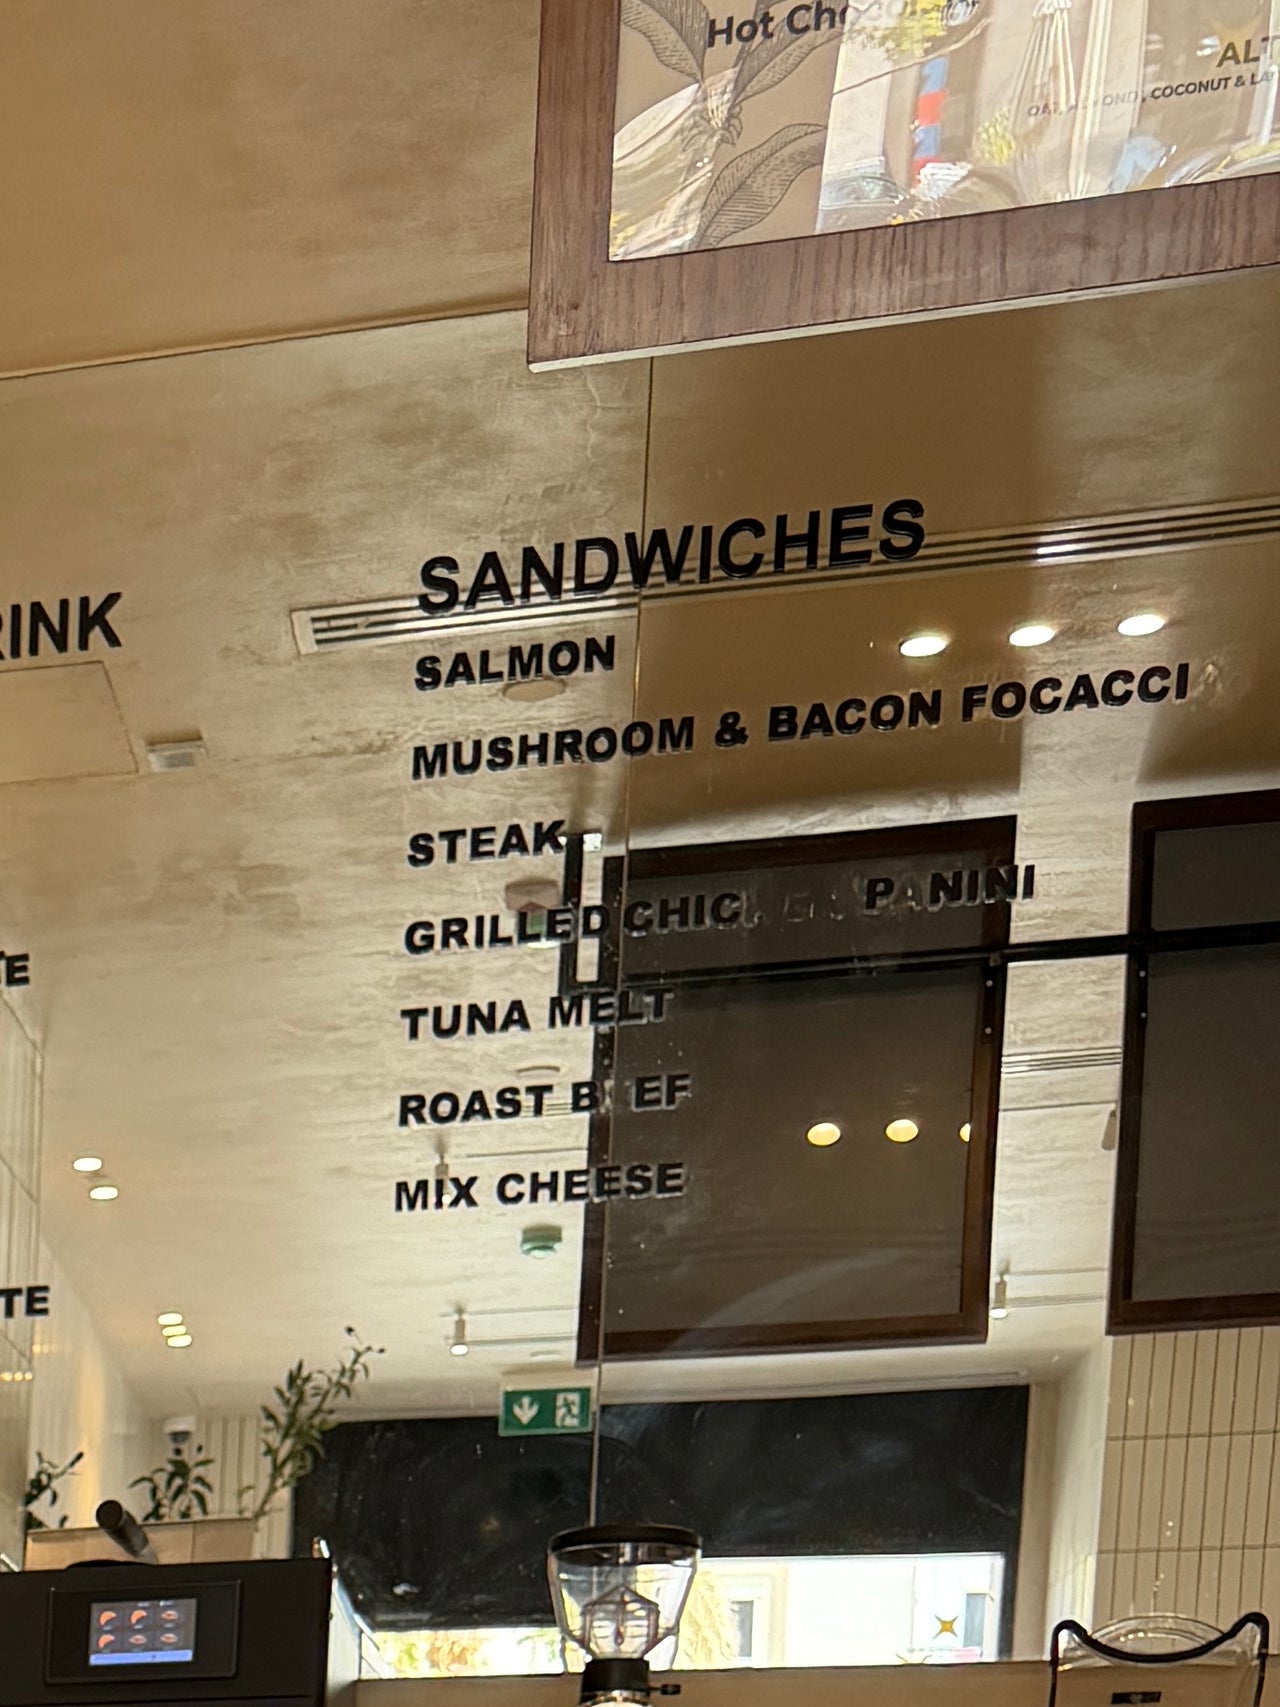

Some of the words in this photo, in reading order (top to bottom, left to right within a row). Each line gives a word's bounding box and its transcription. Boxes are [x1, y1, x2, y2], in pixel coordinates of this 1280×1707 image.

[707, 11, 775, 47] Hot
[1150, 77, 1231, 100] COCONUT
[1234, 75, 1246, 88] &
[418, 499, 926, 617] SANDWICHES
[414, 634, 616, 692] SALMON
[411, 715, 695, 781] MUSHROOM
[714, 710, 750, 750] &
[766, 688, 944, 743] BACON
[960, 662, 1192, 724] FOCACCI
[406, 817, 566, 869] STEAK
[404, 902, 610, 956] GRILLED
[864, 863, 1037, 917] PNINI
[400, 999, 531, 1041] TUNA
[548, 986, 676, 1030] MELT
[398, 1083, 555, 1128] ROAST
[570, 1073, 691, 1115] BEF
[395, 1175, 479, 1213] MIX
[496, 1162, 685, 1206] CHEESE
